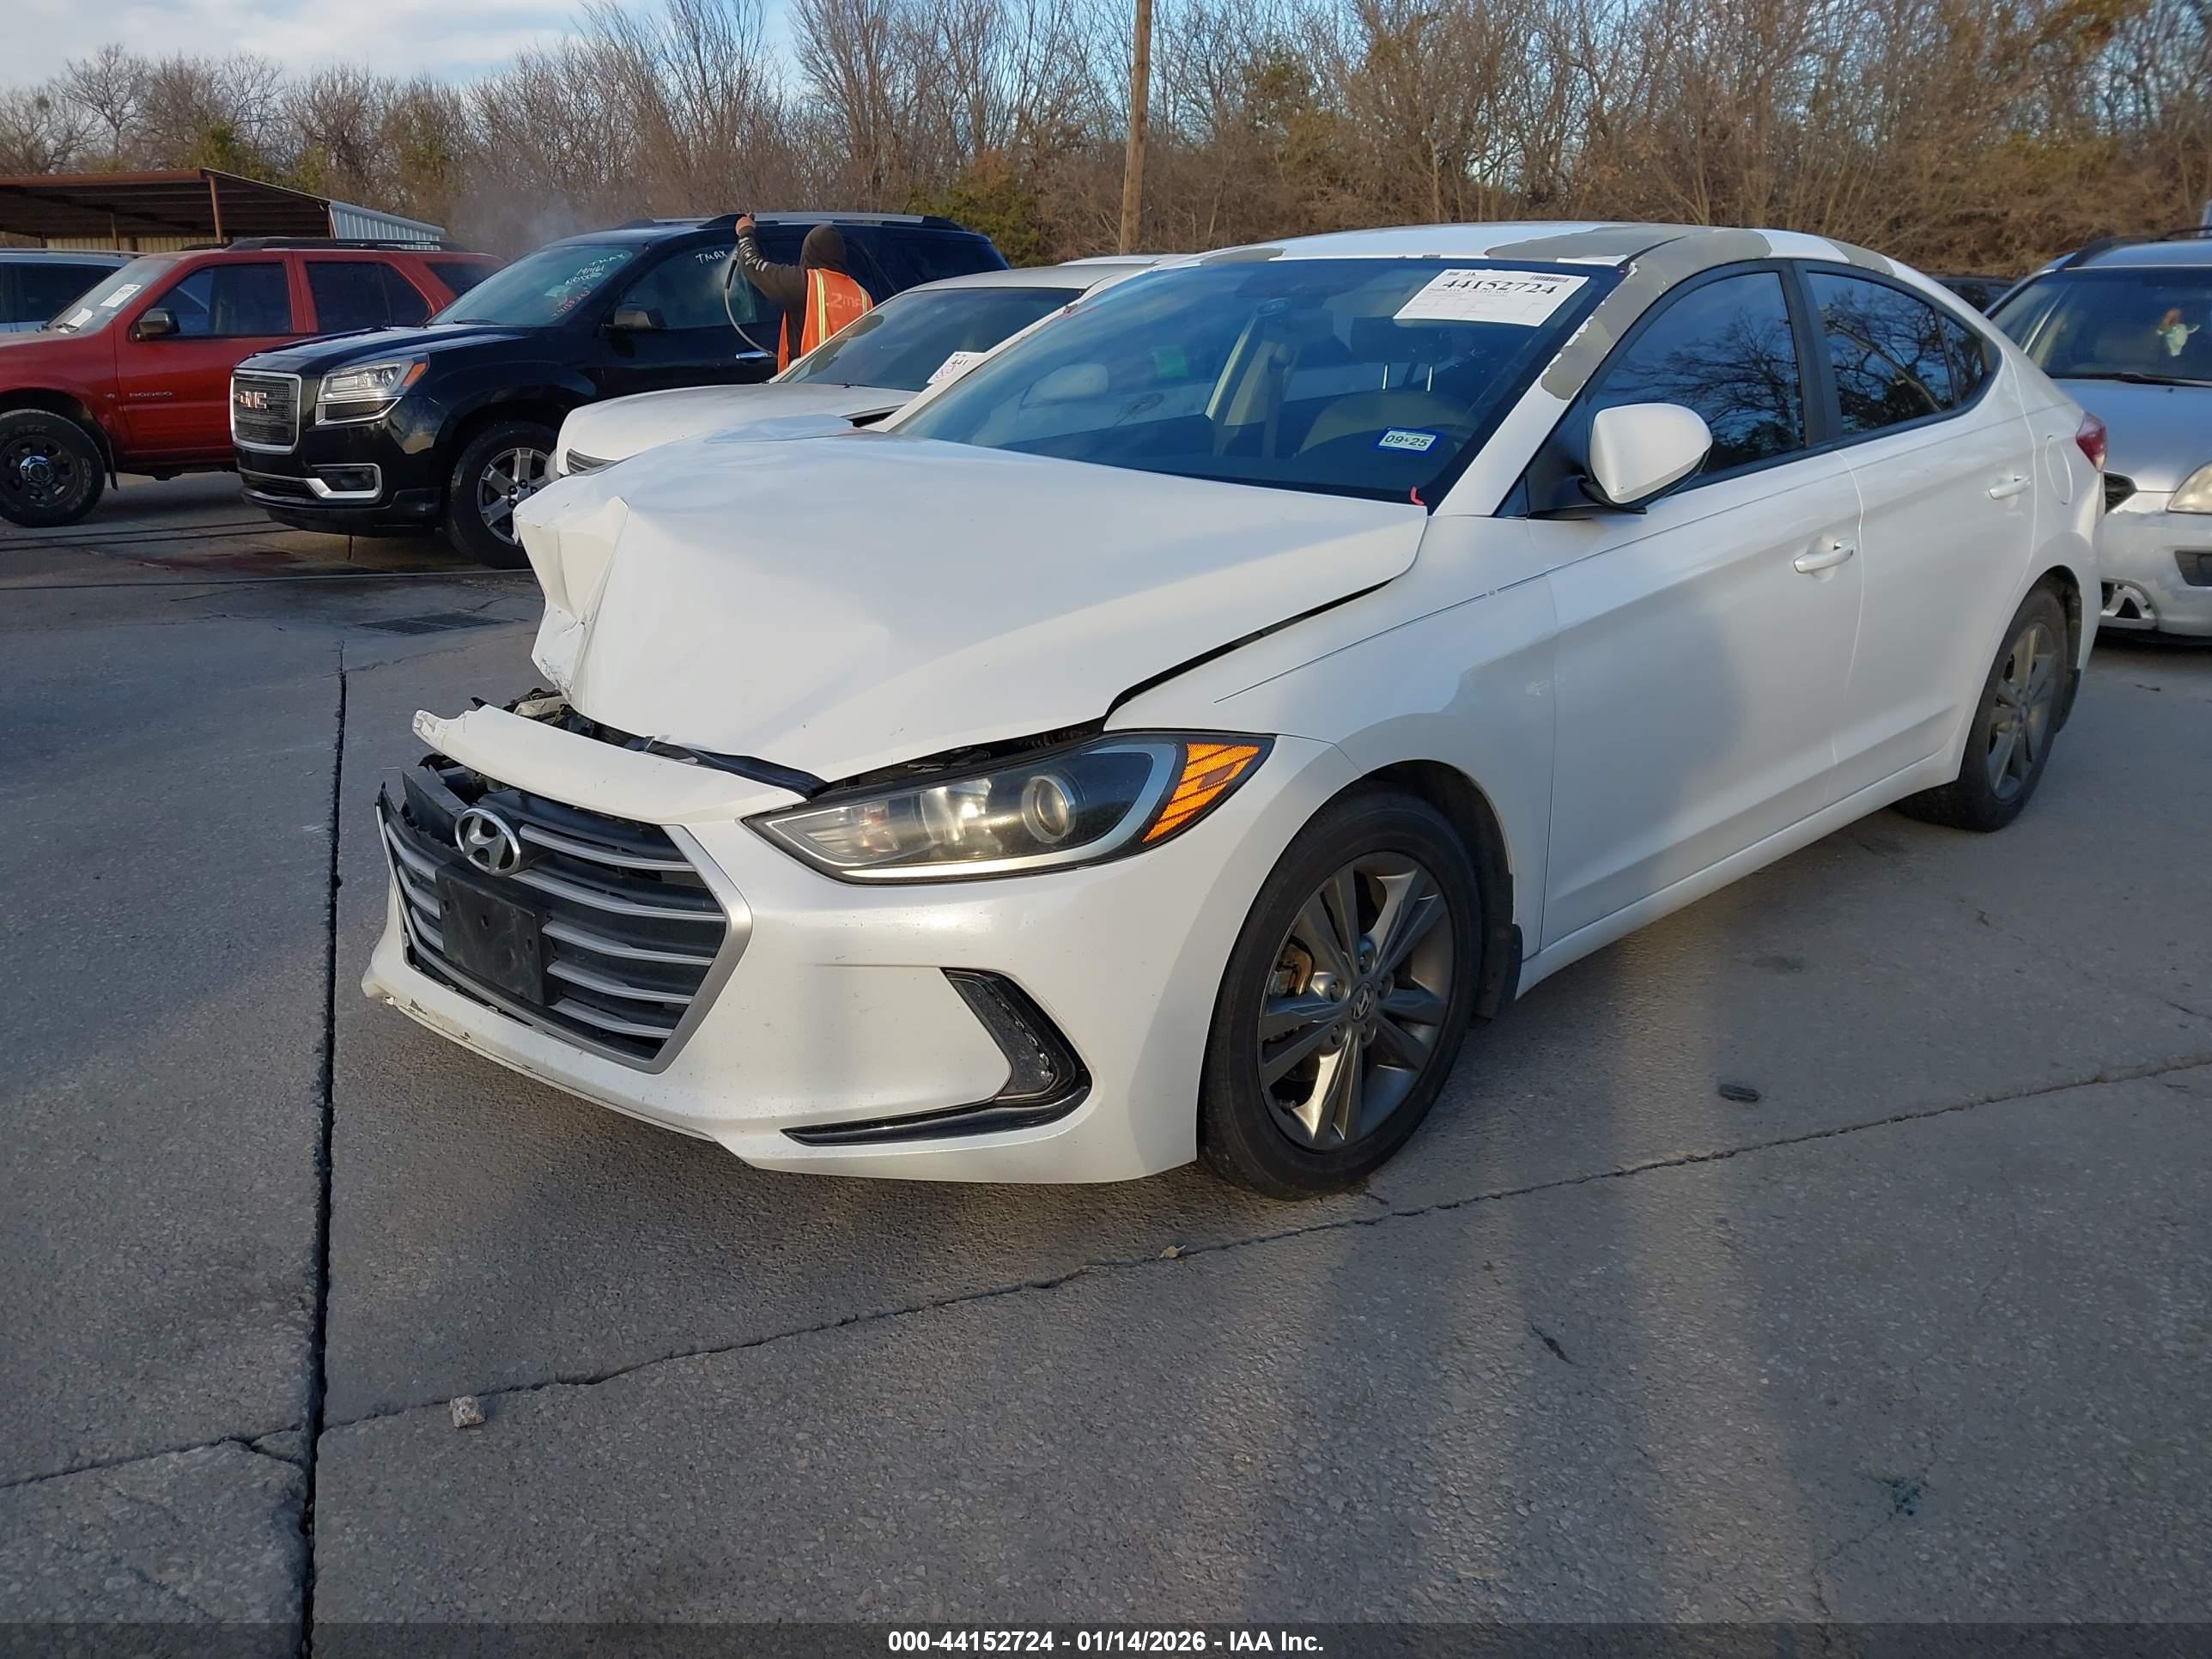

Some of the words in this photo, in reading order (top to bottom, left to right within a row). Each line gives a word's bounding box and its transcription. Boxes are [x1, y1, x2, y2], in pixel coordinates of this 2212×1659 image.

[696, 250, 728, 265] TMAX
[1443, 278, 1559, 294] 44152724
[1384, 434, 1404, 444] 09
[1408, 437, 1430, 447] 25
